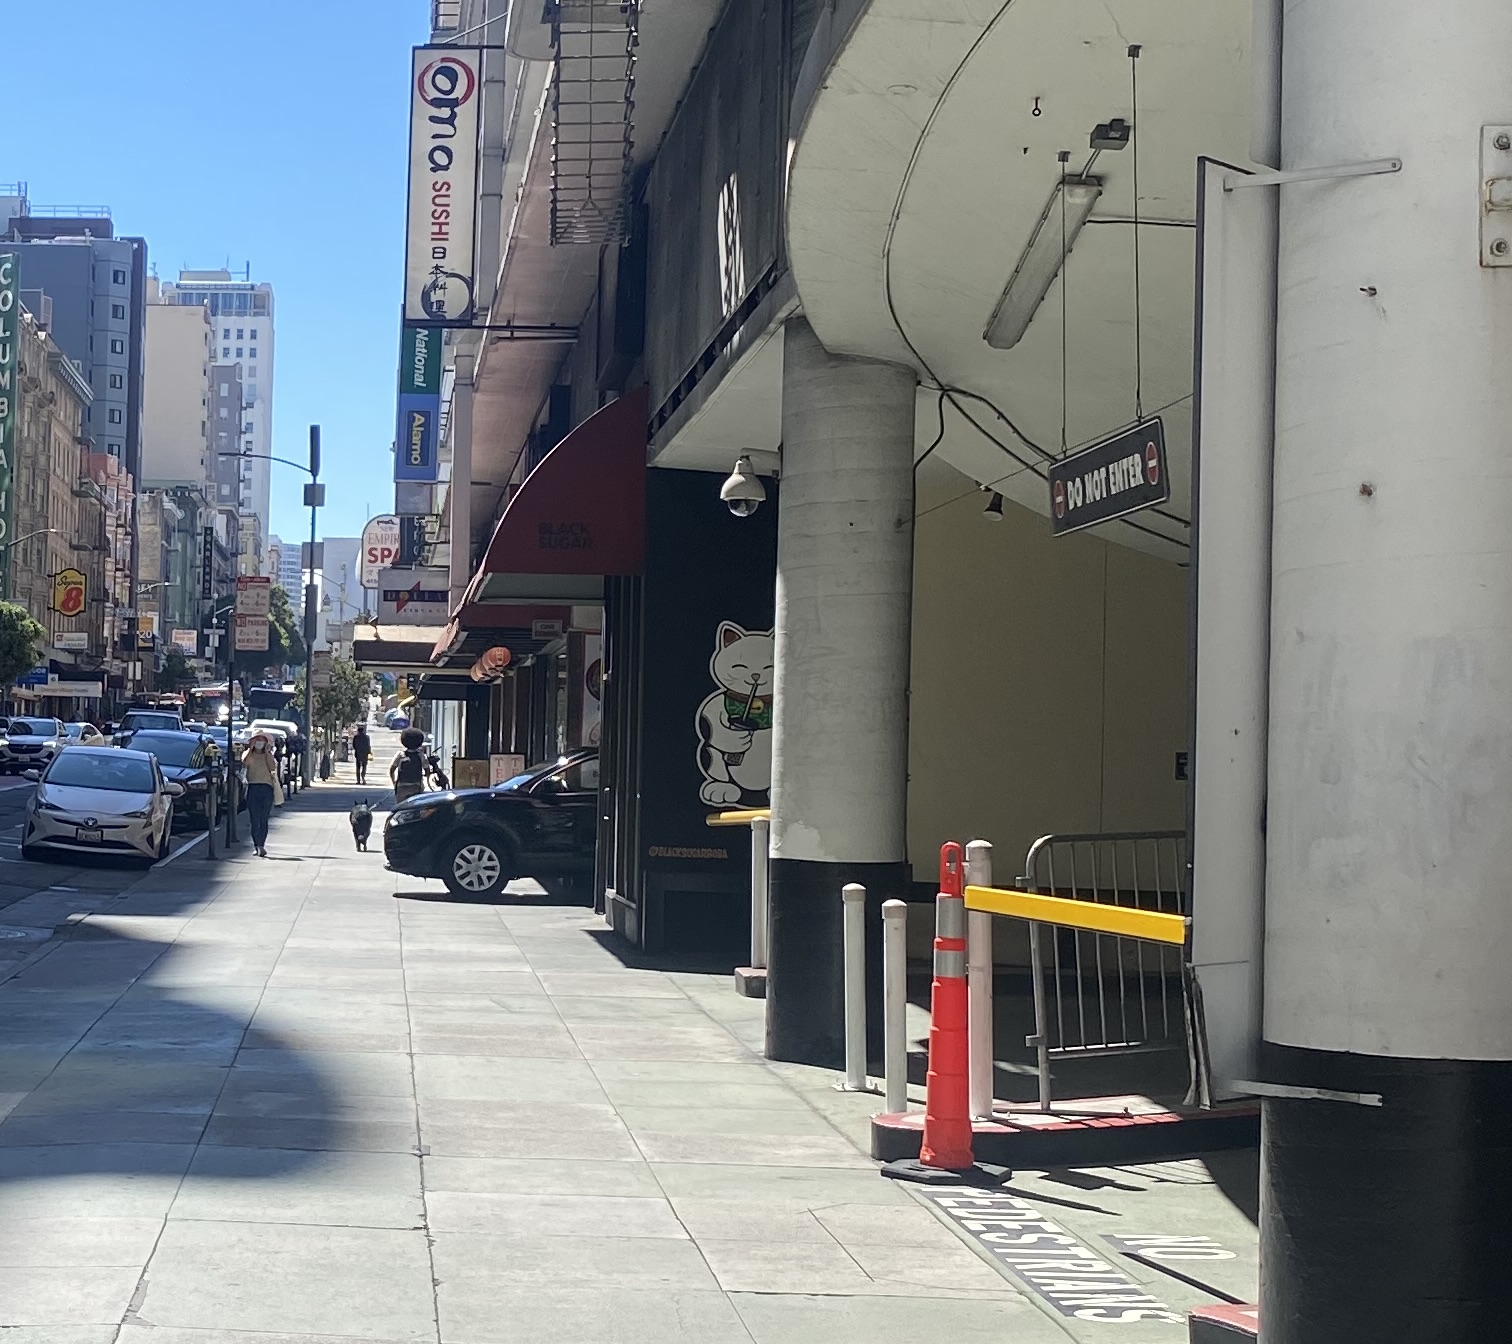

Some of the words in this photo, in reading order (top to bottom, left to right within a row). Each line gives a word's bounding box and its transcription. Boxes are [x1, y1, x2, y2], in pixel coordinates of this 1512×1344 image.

[431, 180, 451, 242] SUSHI
[414, 328, 429, 387] National
[411, 413, 425, 465] Alamo
[1066, 477, 1083, 511] DO
[1084, 467, 1108, 505] NOT
[1108, 453, 1145, 495] ENTER
[368, 533, 399, 546] EMPIR
[60, 586, 84, 612] 8
[920, 1185, 1186, 1324] PEDESTRIANS
[1112, 1233, 1237, 1260] NO
